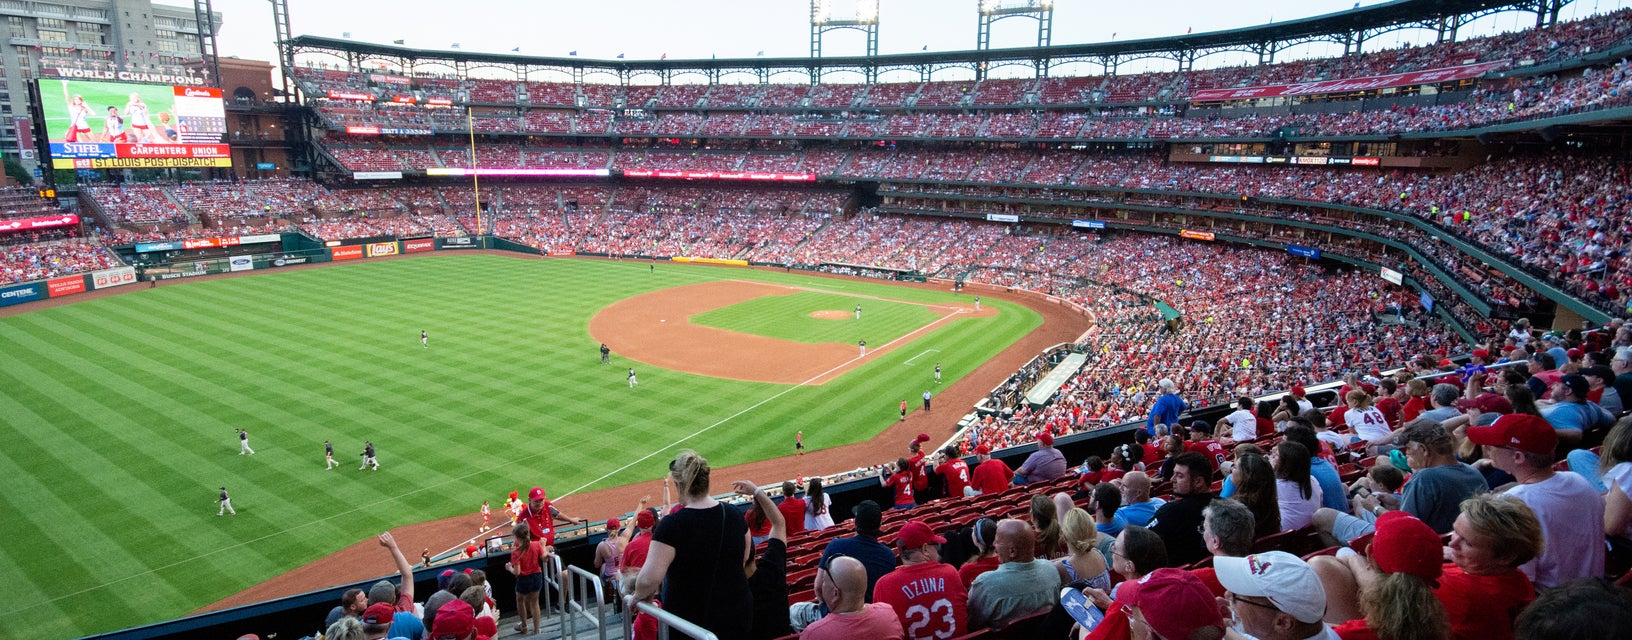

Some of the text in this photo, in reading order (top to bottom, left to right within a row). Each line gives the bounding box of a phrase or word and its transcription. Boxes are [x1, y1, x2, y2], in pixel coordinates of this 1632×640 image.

[56, 67, 204, 85] WORLD CHAMPIONS
[64, 143, 103, 154] STIFEL
[130, 146, 218, 155] CARPENTERS UNION
[95, 157, 216, 167] ST. LOUIS POST-DISPATCH
[1363, 411, 1384, 425] 48
[960, 469, 968, 482] 4
[904, 484, 911, 495] 4
[901, 577, 945, 600] OZUNA
[905, 598, 956, 640] 23
